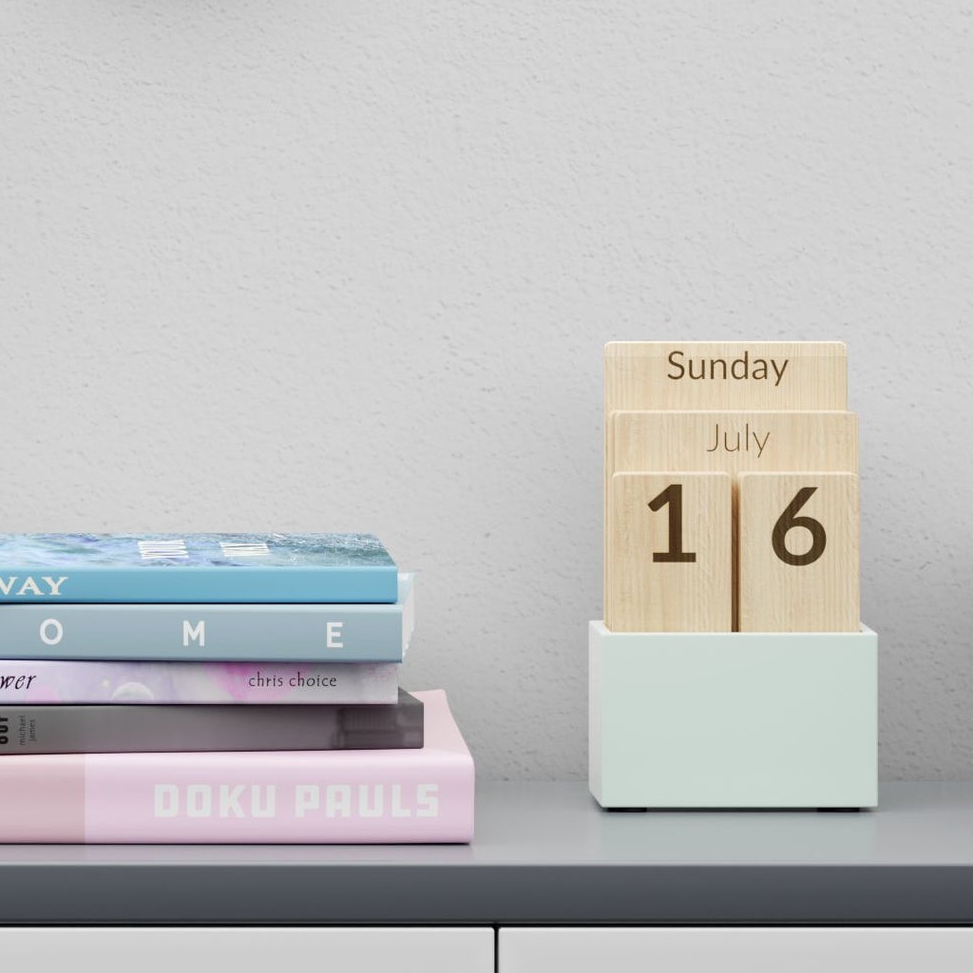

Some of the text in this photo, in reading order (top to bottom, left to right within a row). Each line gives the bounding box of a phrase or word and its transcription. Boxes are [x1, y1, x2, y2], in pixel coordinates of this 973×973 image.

[667, 350, 789, 387] Sunday
[706, 423, 771, 458] July
[647, 484, 827, 567] 1 6
[248, 672, 338, 688] chris choice
[154, 783, 439, 818] DOKU PAULS
